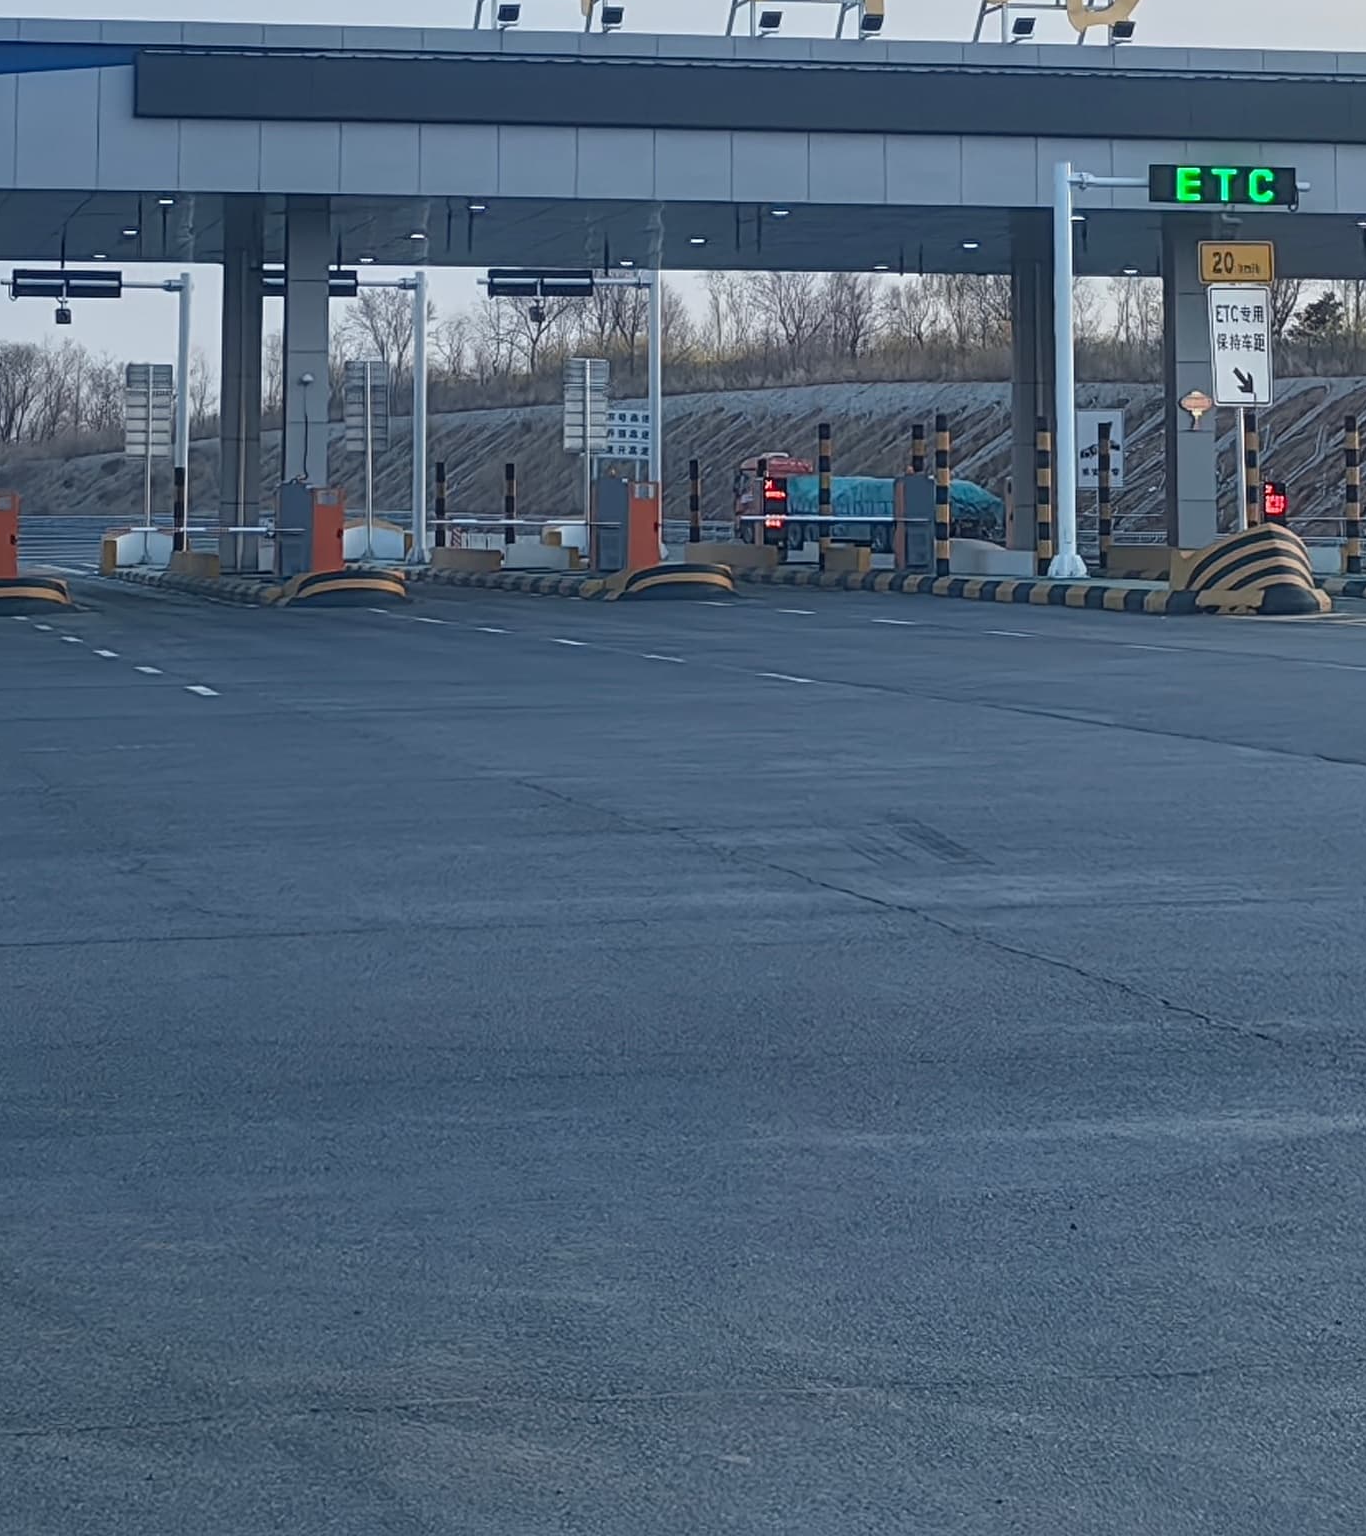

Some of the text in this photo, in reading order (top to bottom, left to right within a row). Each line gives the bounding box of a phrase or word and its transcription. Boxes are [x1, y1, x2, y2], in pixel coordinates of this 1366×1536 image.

[1176, 167, 1274, 202] ETC
[1212, 251, 1234, 274] 20
[1215, 304, 1264, 323] ETC专用
[1217, 333, 1266, 352] 保持车距
